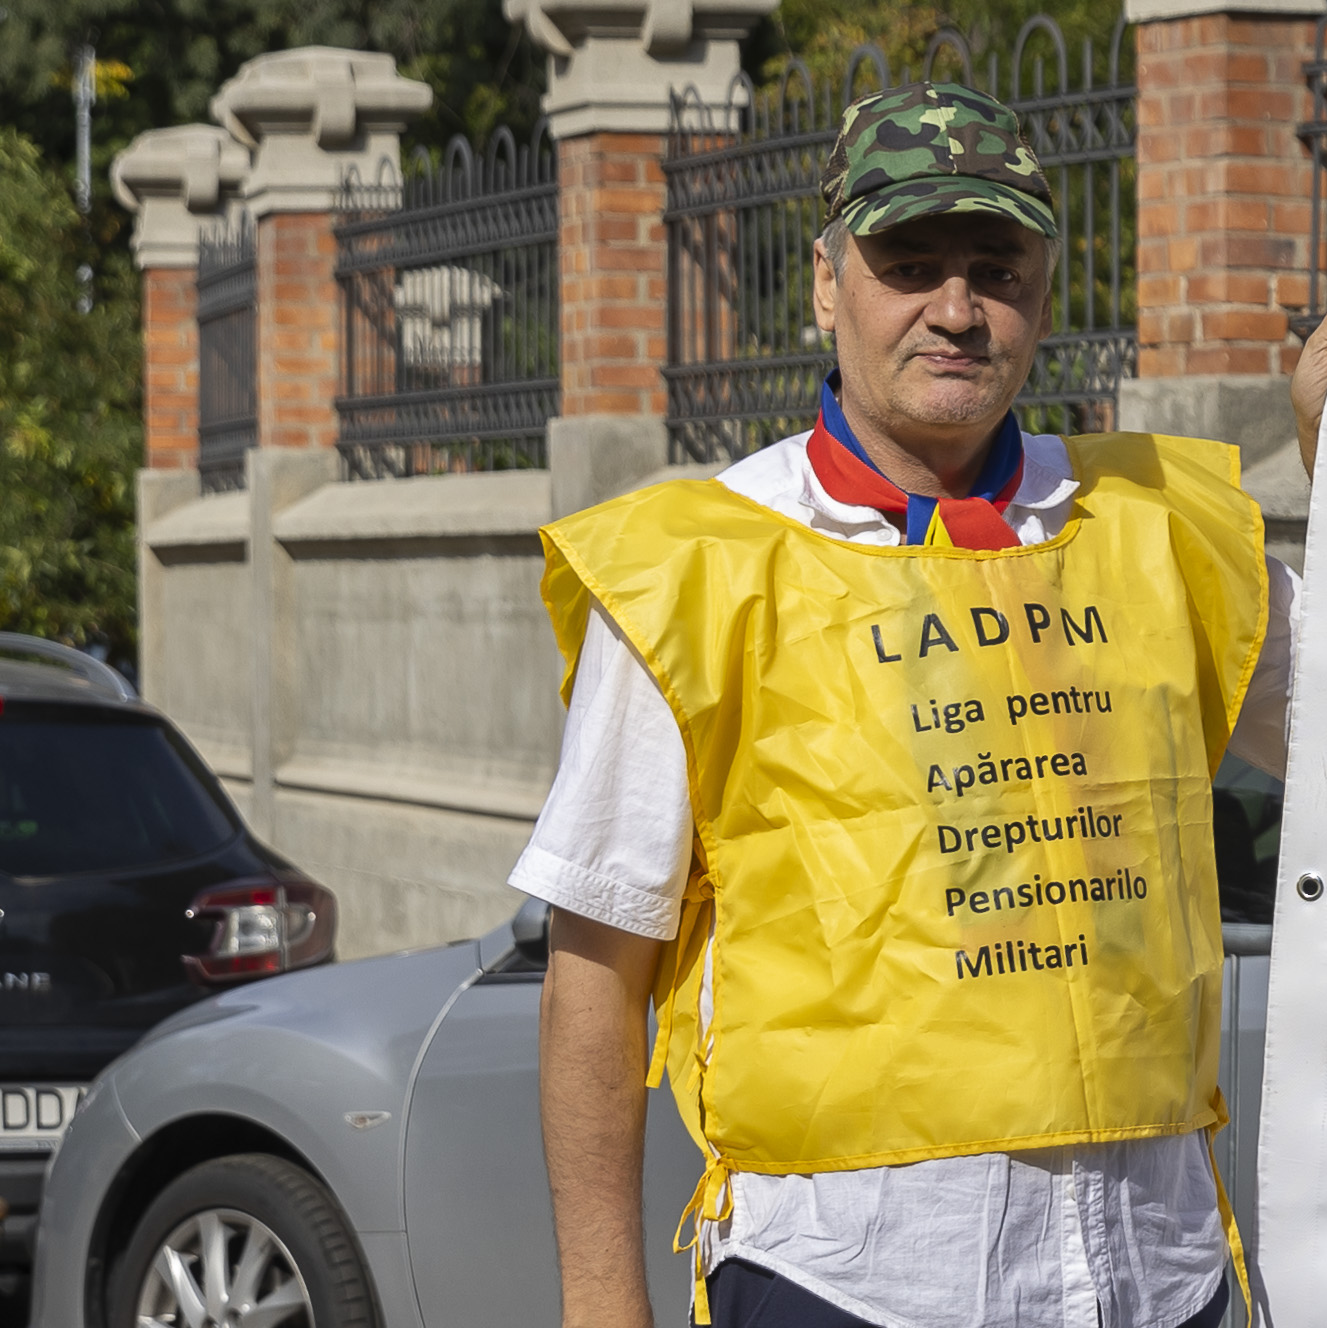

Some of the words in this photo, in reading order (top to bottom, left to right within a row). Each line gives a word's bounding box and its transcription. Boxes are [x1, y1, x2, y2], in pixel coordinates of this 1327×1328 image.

[910, 699, 985, 734] Liga
[1006, 685, 1112, 726] pentru
[926, 750, 1088, 797] Apărarea
[937, 806, 1122, 854] Drepturilor
[944, 868, 1147, 917] Pensionarilo
[954, 935, 1089, 979] Militari
[0, 972, 51, 992] NE
